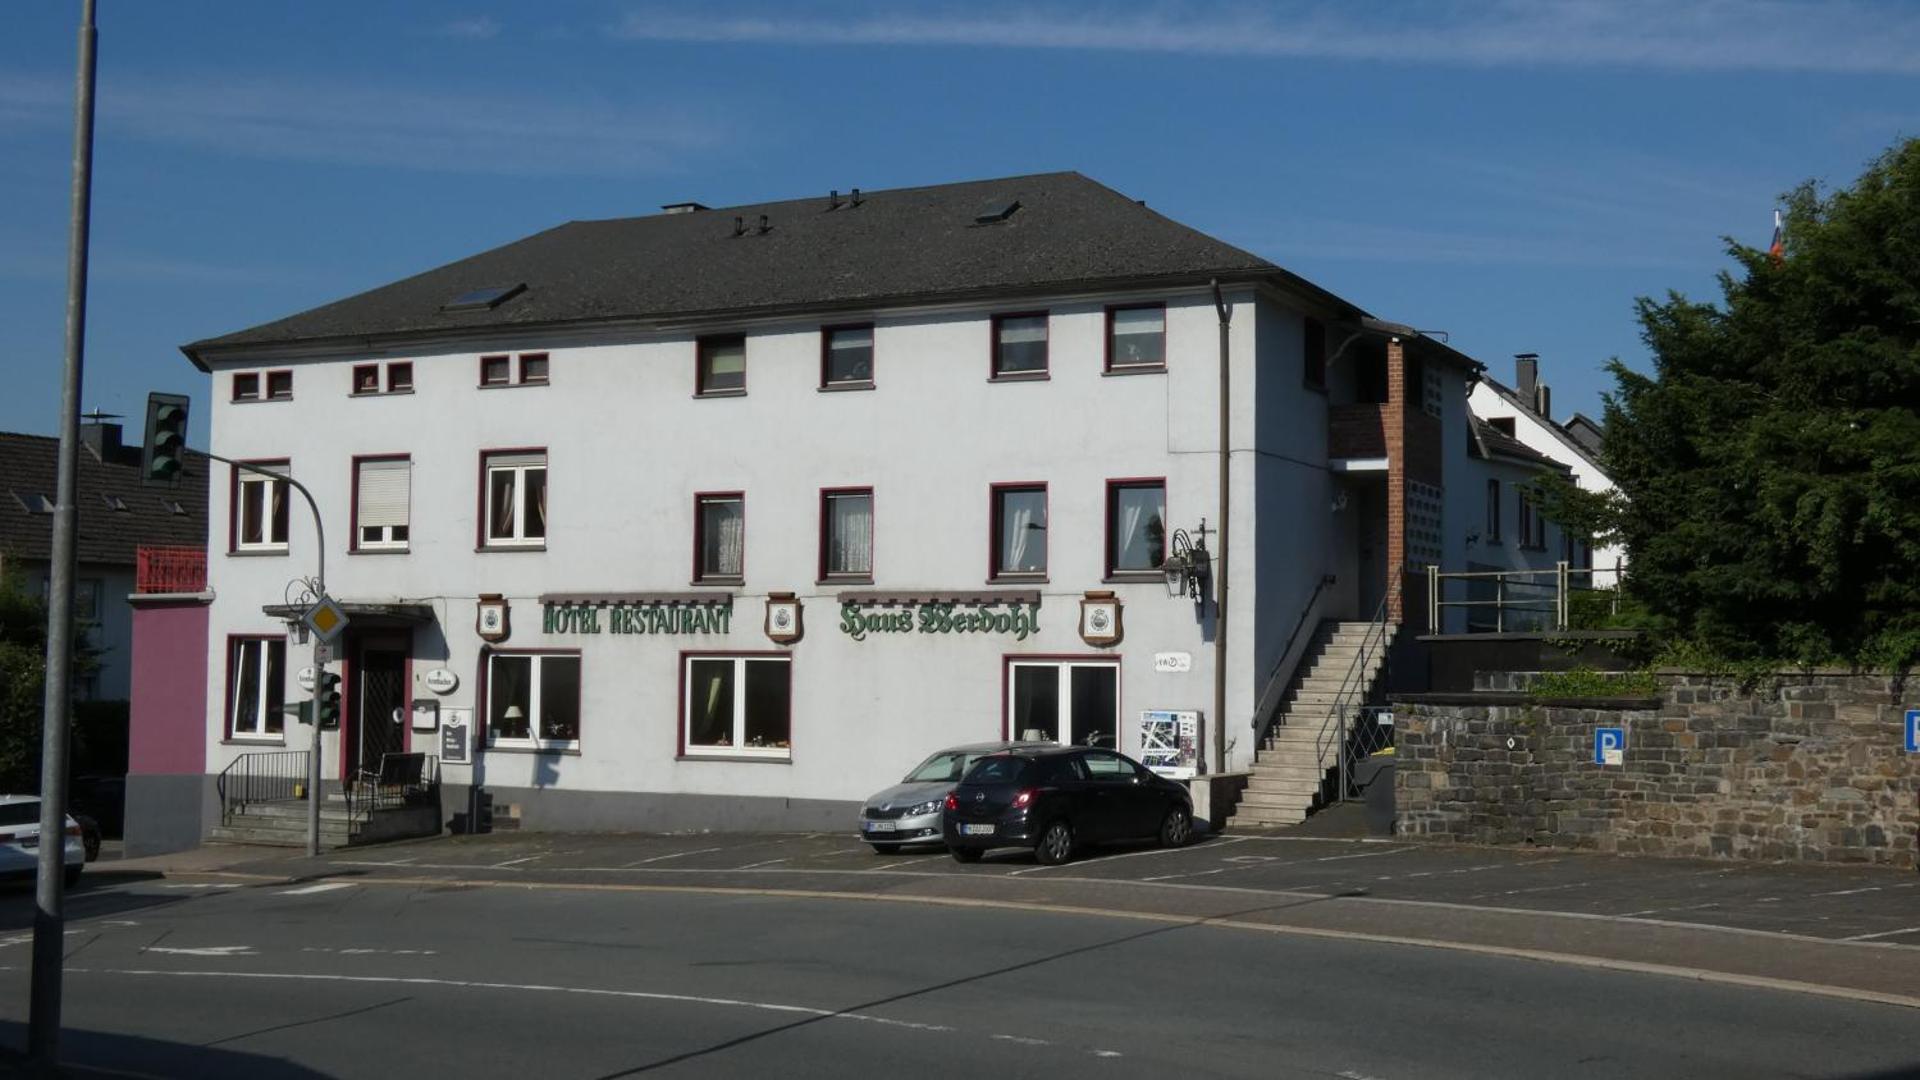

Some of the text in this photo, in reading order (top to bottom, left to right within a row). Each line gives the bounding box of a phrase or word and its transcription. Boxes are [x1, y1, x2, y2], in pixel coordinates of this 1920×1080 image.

[542, 603, 732, 635] HOTEL RESTAURANT
[840, 603, 1041, 641] Haus Werdohl
[1602, 733, 1617, 760] P
